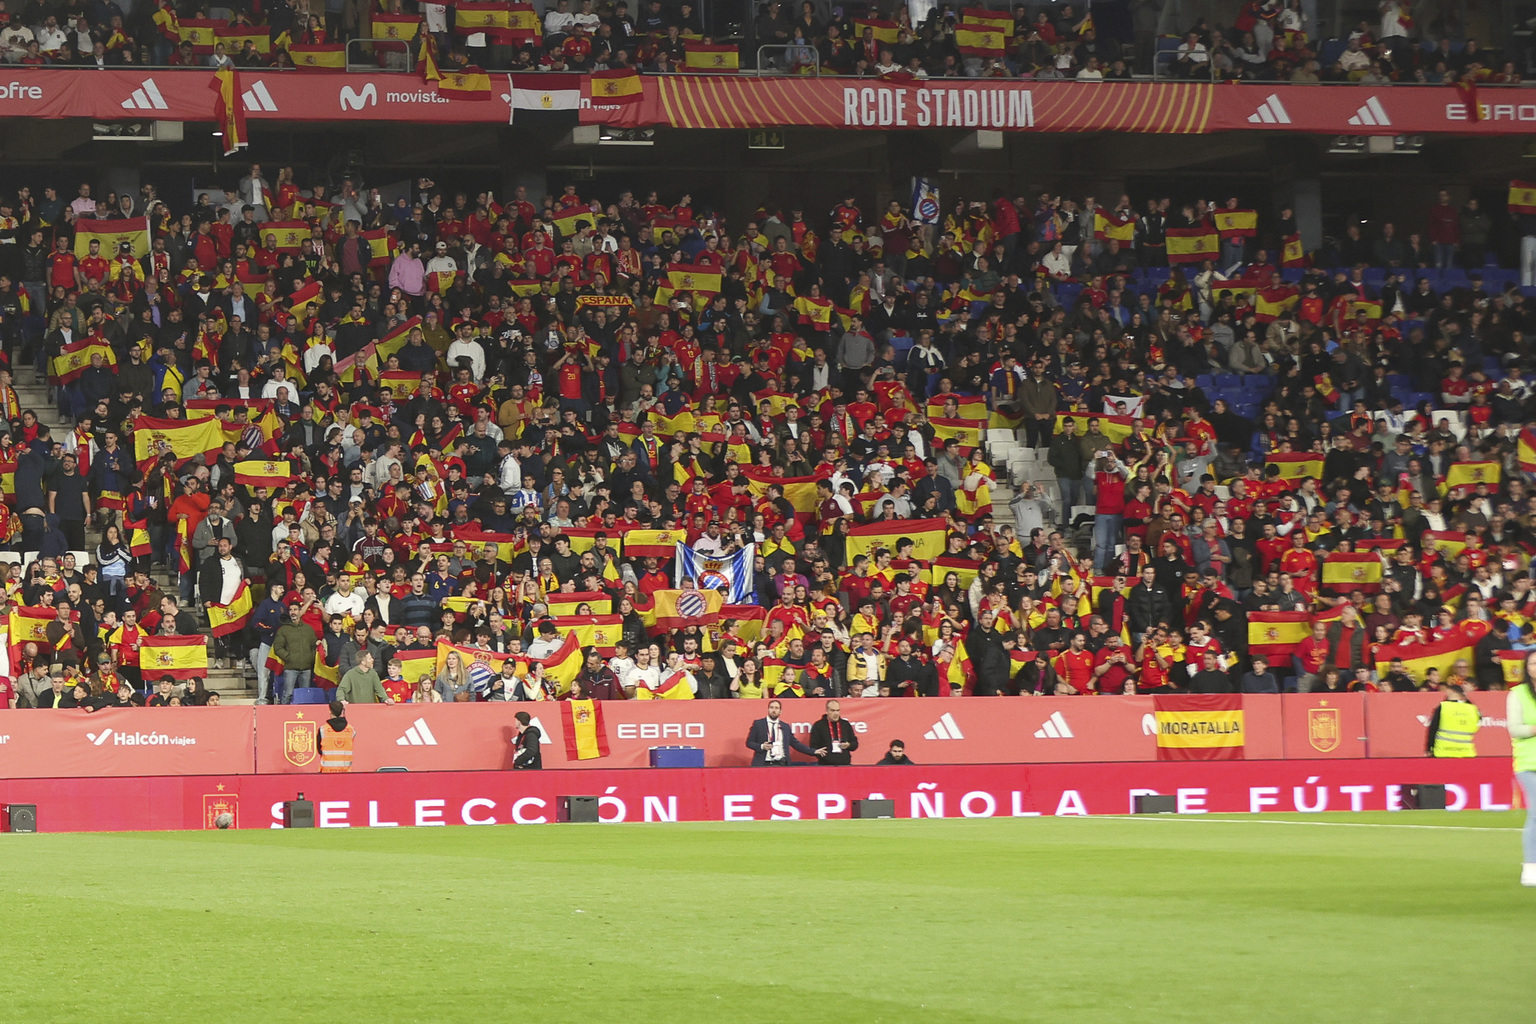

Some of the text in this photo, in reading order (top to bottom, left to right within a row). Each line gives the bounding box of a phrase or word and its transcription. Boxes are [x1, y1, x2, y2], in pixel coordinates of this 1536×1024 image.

[844, 87, 1035, 129] RCDE STADIUM
[617, 723, 705, 739] EBRO
[1160, 720, 1241, 735] MORATALLA
[114, 731, 196, 747] Halcón viajes
[270, 786, 678, 829] ELECCÓN
[722, 782, 1089, 821] ESPÑOLA
